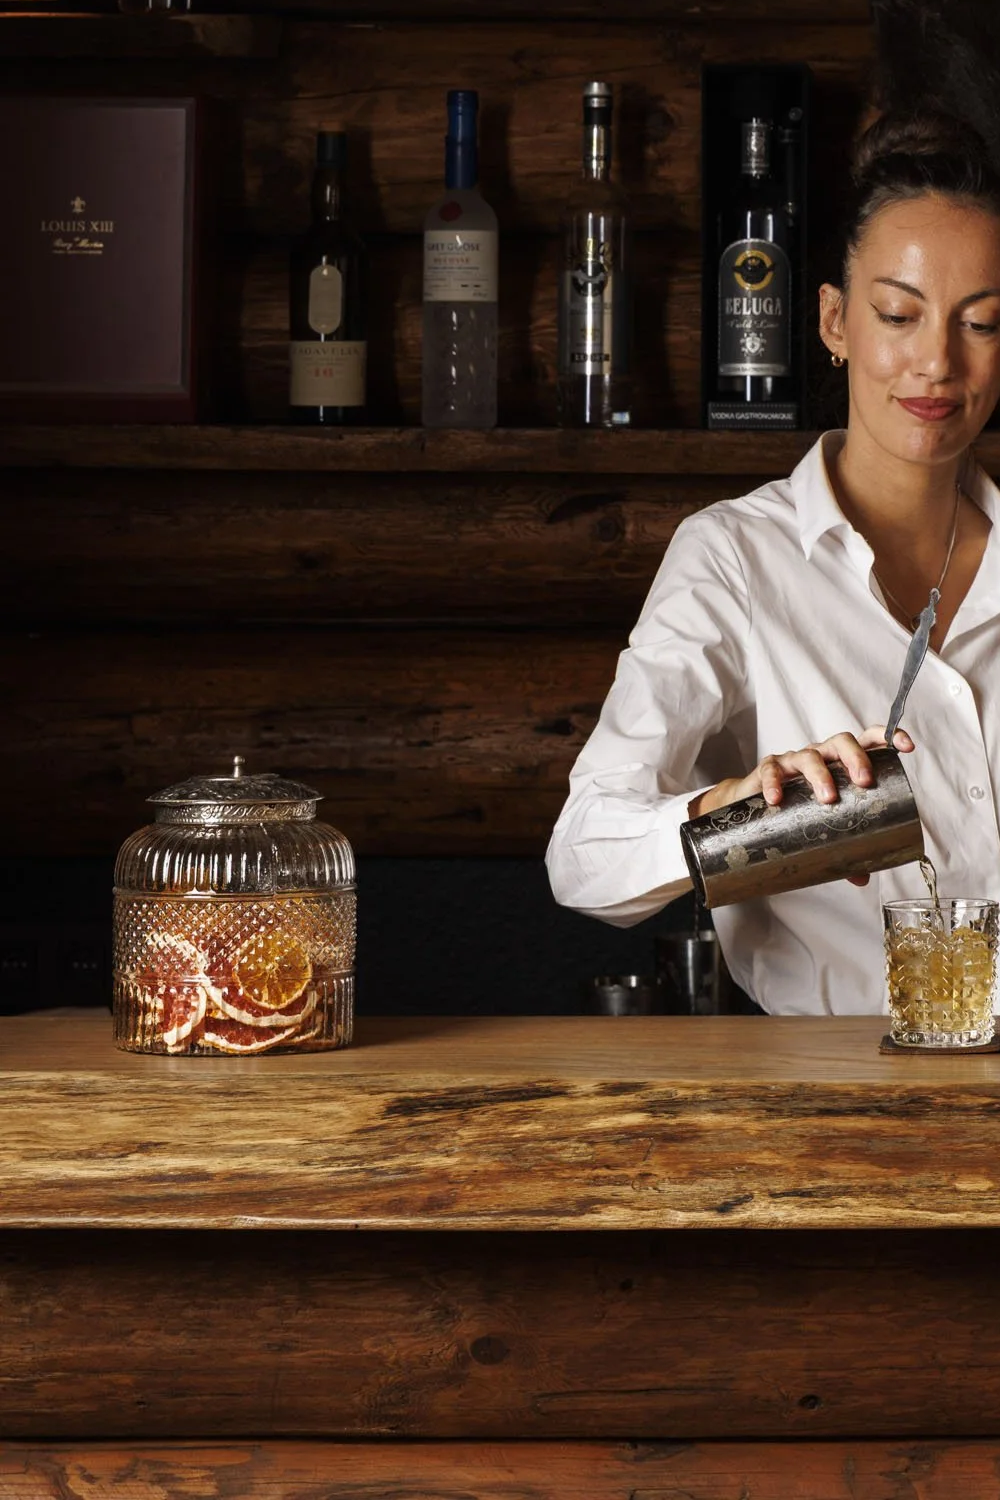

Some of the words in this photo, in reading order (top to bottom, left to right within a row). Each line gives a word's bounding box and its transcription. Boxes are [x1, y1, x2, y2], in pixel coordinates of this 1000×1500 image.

[40, 220, 87, 232] LOUIS
[89, 220, 115, 232] XIII
[725, 297, 783, 316] BELUGA
[711, 411, 735, 420] VODKA
